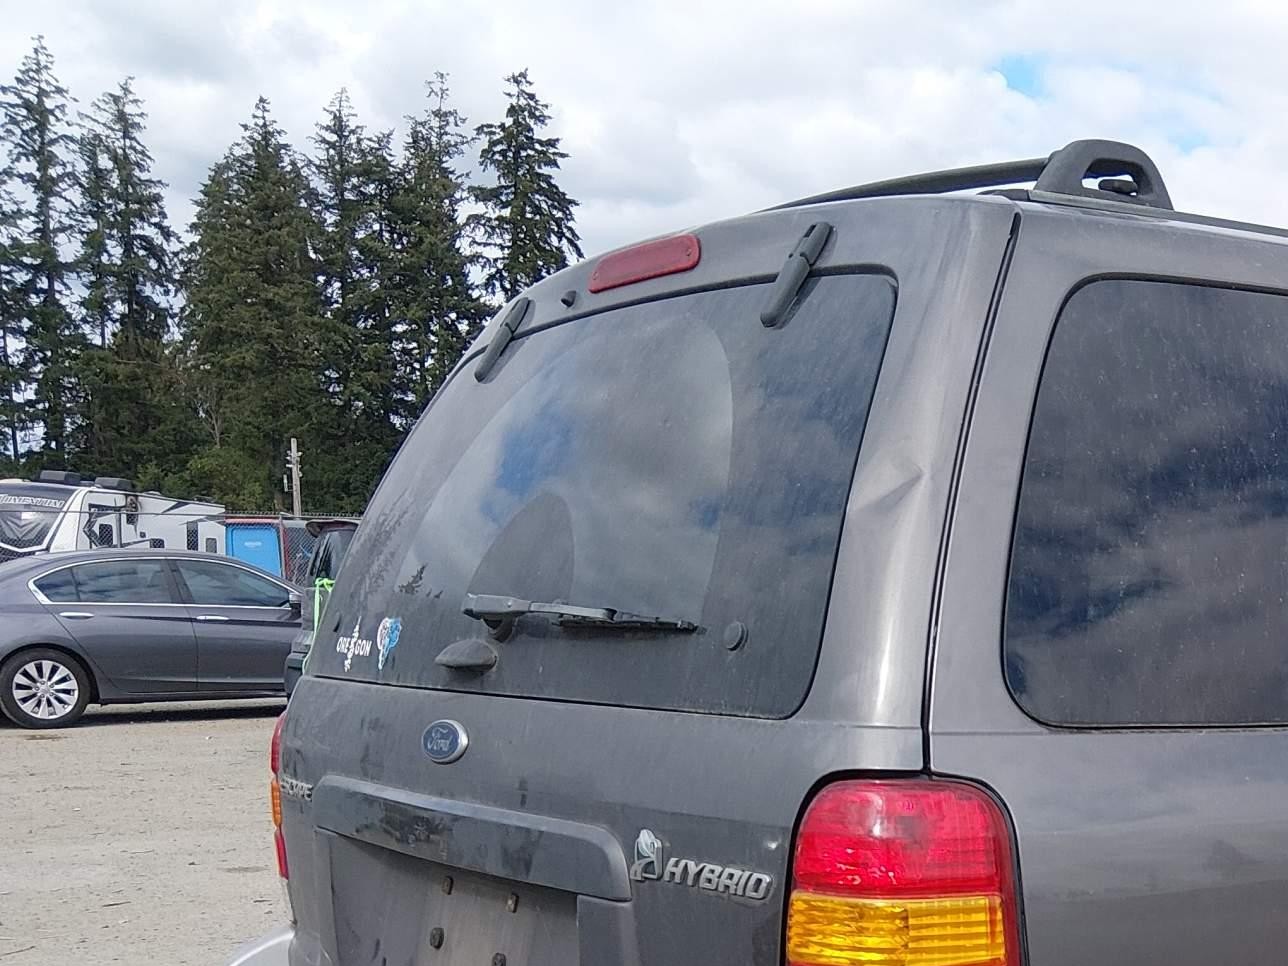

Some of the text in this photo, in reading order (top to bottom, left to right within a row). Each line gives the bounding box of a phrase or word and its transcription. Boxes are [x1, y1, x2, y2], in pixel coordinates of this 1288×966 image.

[336, 637, 373, 656] OREGON
[427, 727, 453, 752] Ford
[663, 857, 773, 900] HYBRID
